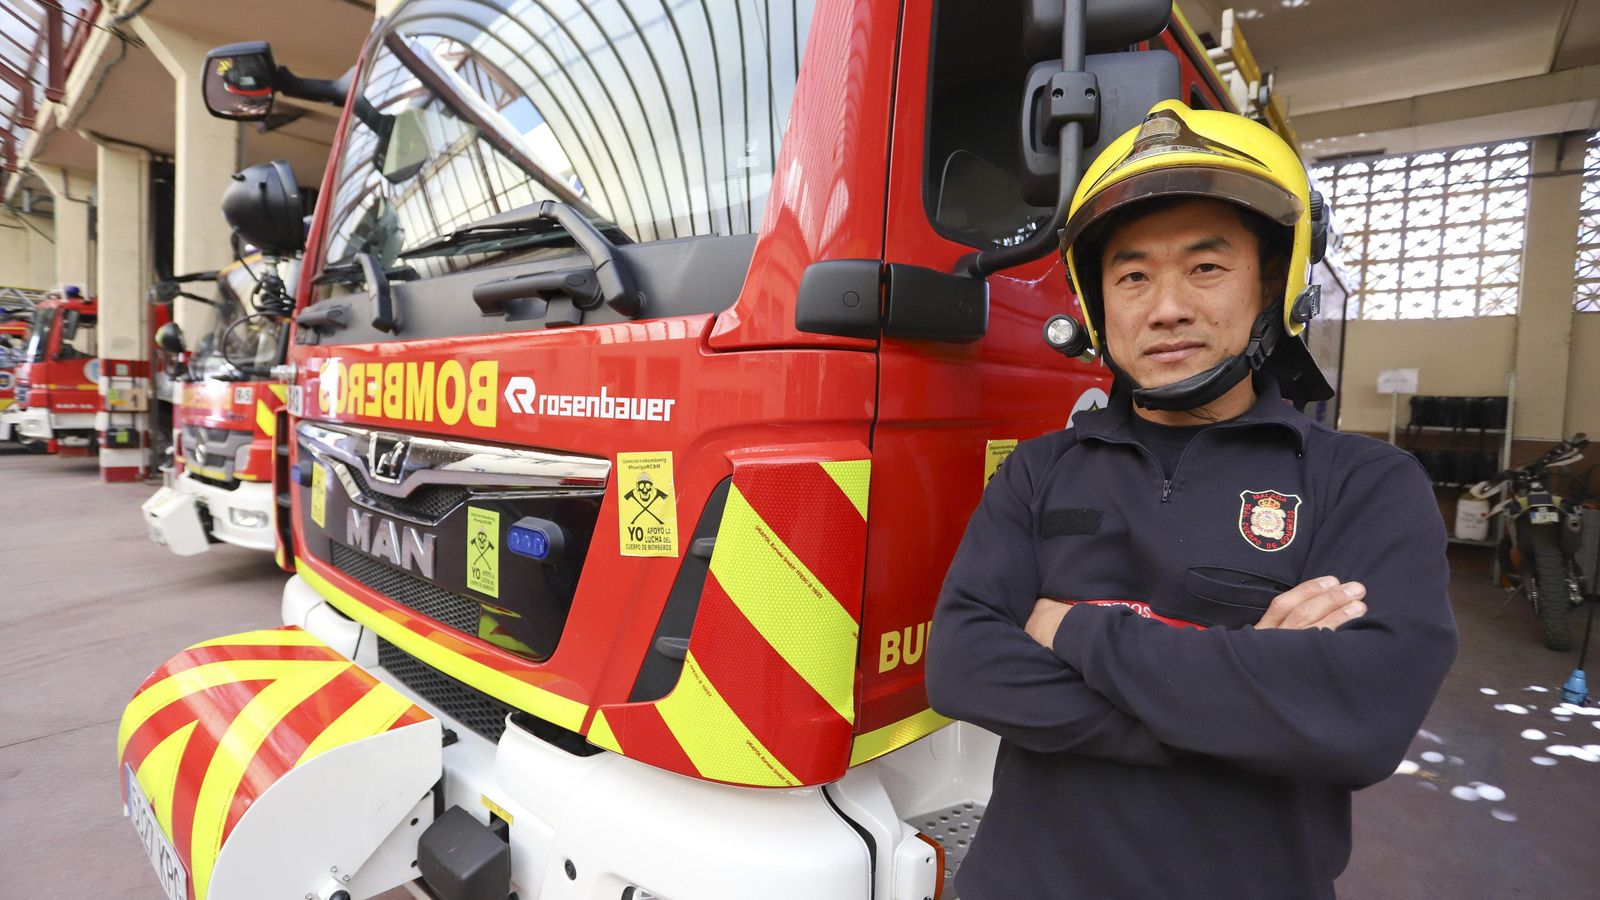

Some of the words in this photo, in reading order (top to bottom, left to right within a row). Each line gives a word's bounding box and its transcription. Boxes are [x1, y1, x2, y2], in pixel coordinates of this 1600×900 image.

[538, 386, 676, 422] rosenbauer
[628, 526, 644, 542] YO
[647, 527, 665, 535] APOYO
[346, 507, 437, 580] MAN
[645, 535, 662, 543] LUCHA
[472, 566, 481, 580] YO
